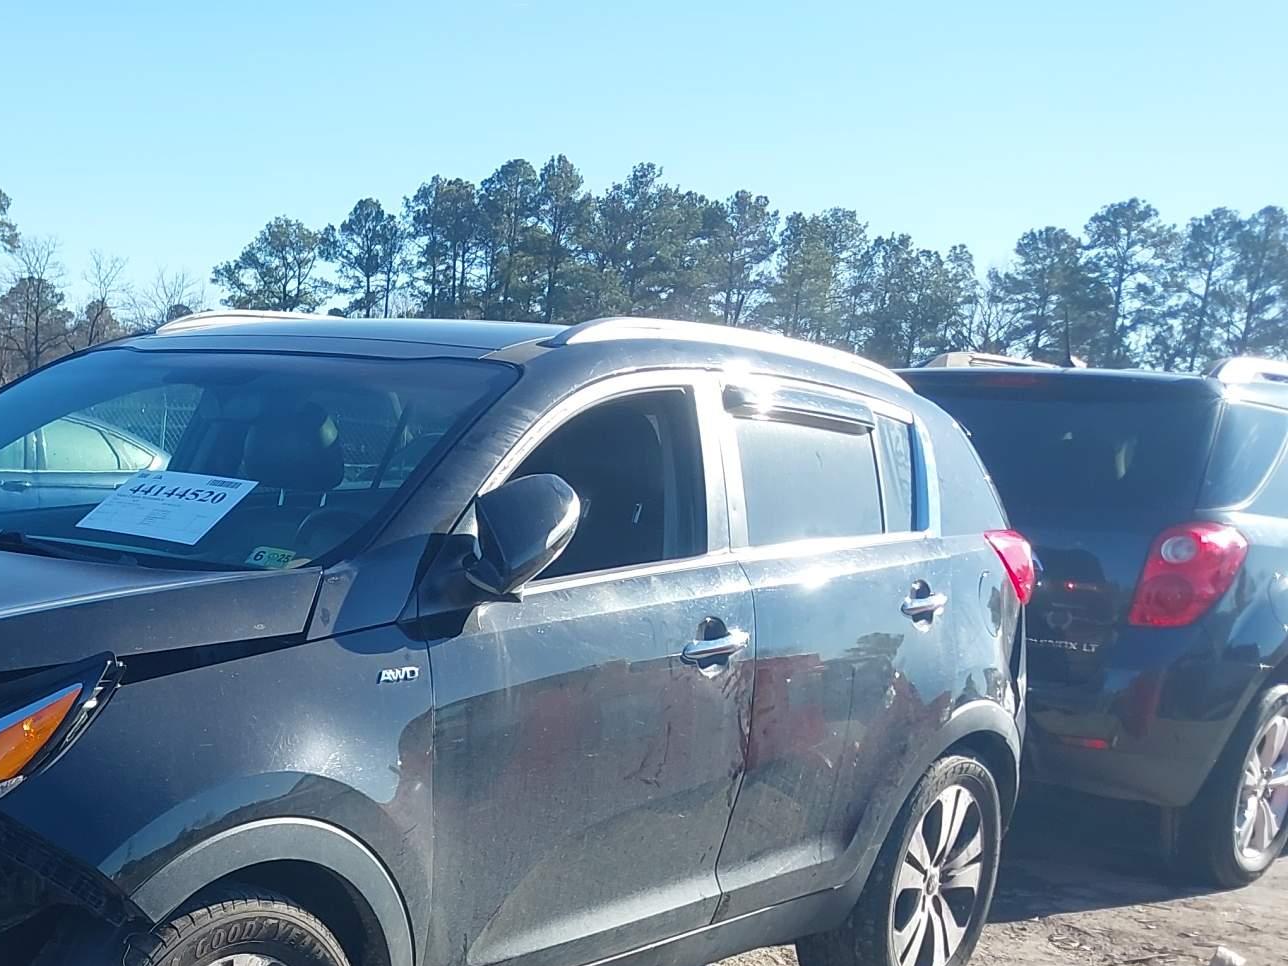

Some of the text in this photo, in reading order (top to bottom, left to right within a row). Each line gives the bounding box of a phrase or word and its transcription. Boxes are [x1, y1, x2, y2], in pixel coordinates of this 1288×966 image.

[129, 483, 228, 505] 44144520
[253, 550, 267, 562] 6
[1082, 643, 1099, 654] LT
[377, 666, 420, 683] AWD
